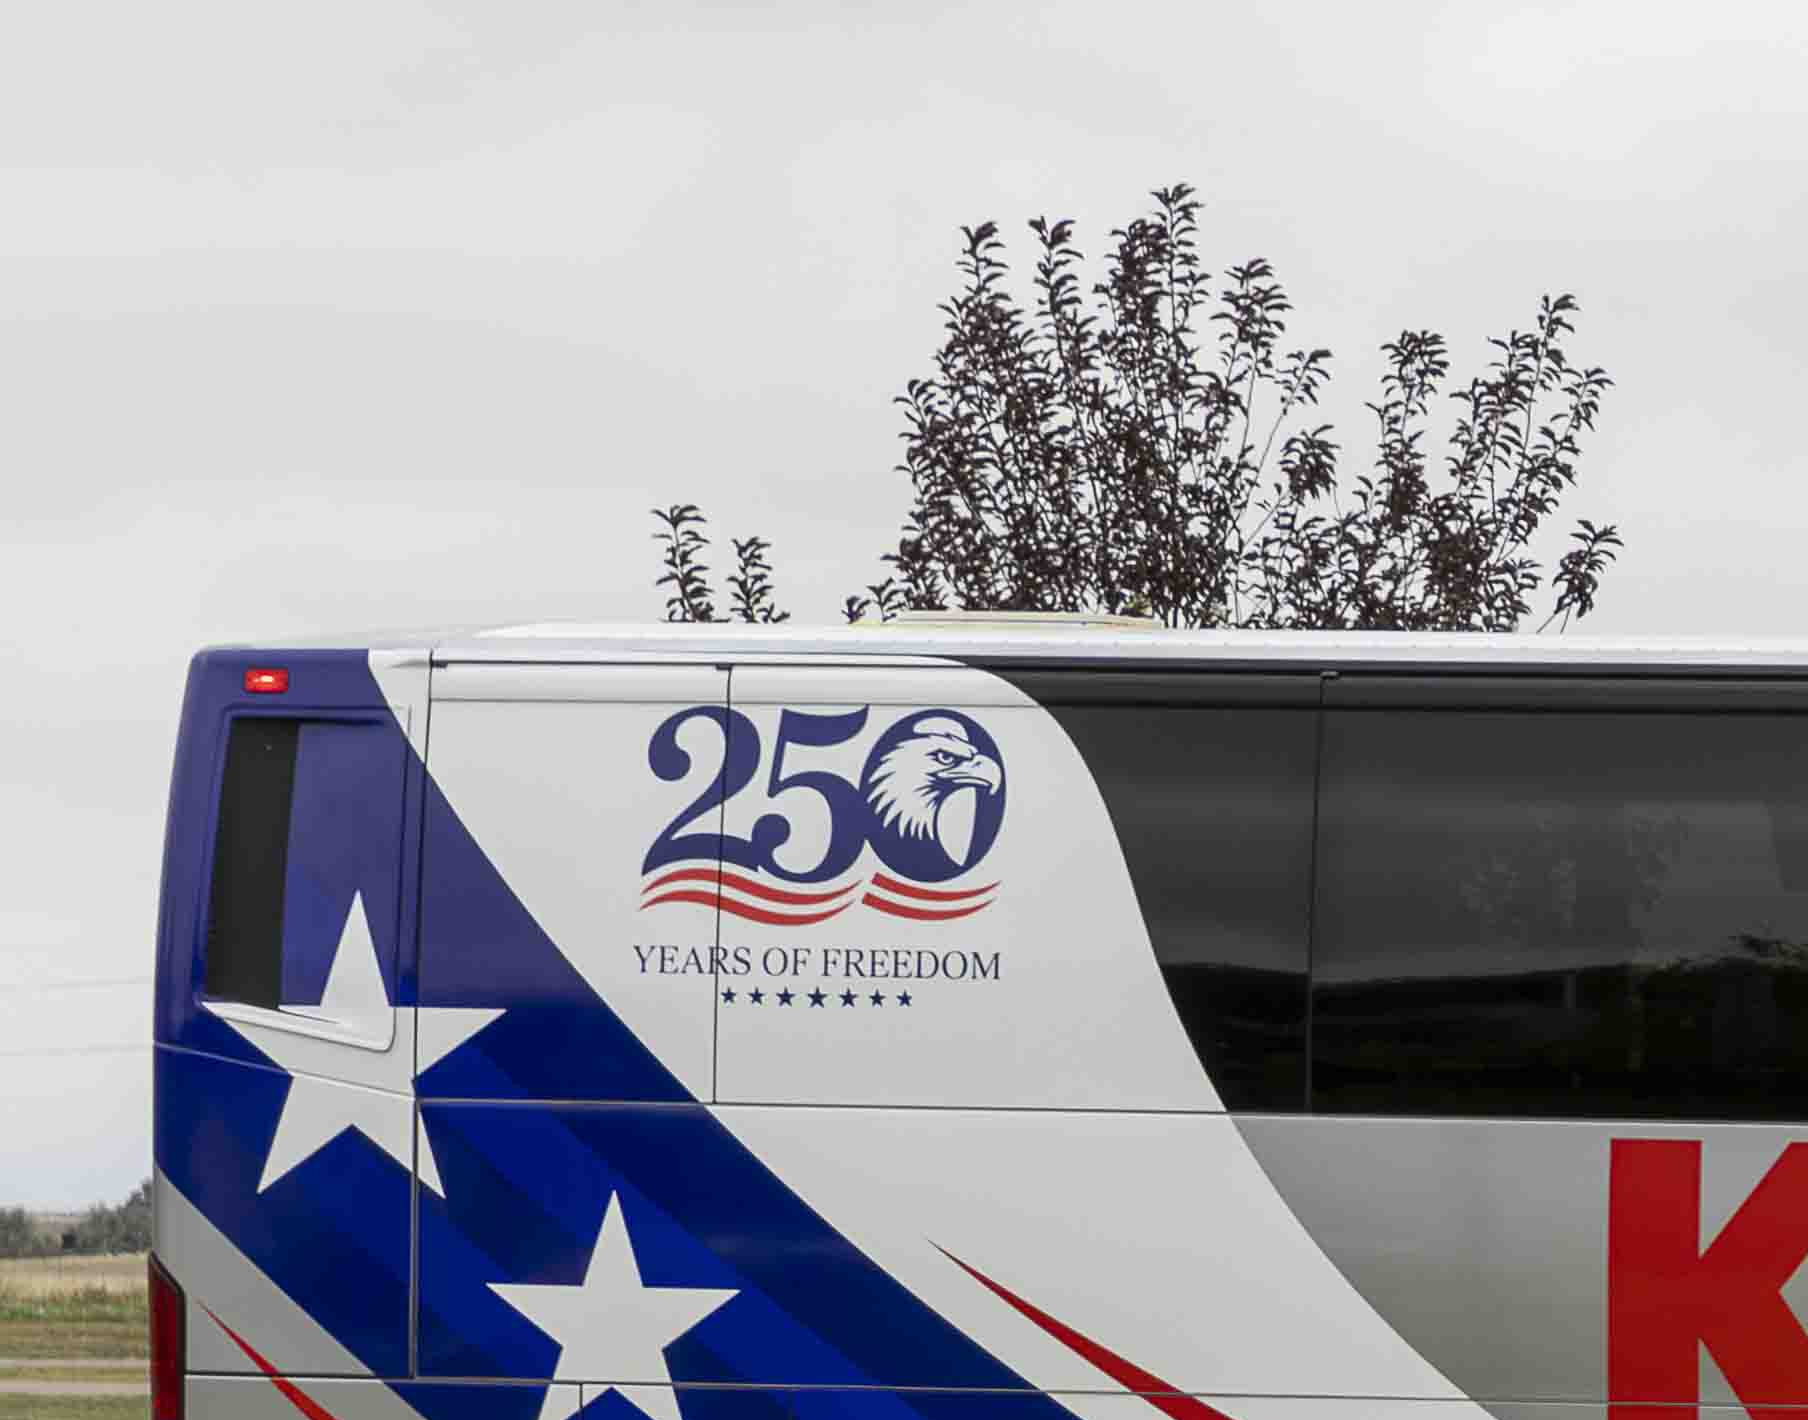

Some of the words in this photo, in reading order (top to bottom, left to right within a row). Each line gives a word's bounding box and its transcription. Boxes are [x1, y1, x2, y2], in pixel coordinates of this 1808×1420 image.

[642, 704, 1006, 884] 250
[633, 945, 751, 975] YEARS
[762, 947, 811, 976] OF
[821, 949, 1001, 980] FREEDOM
